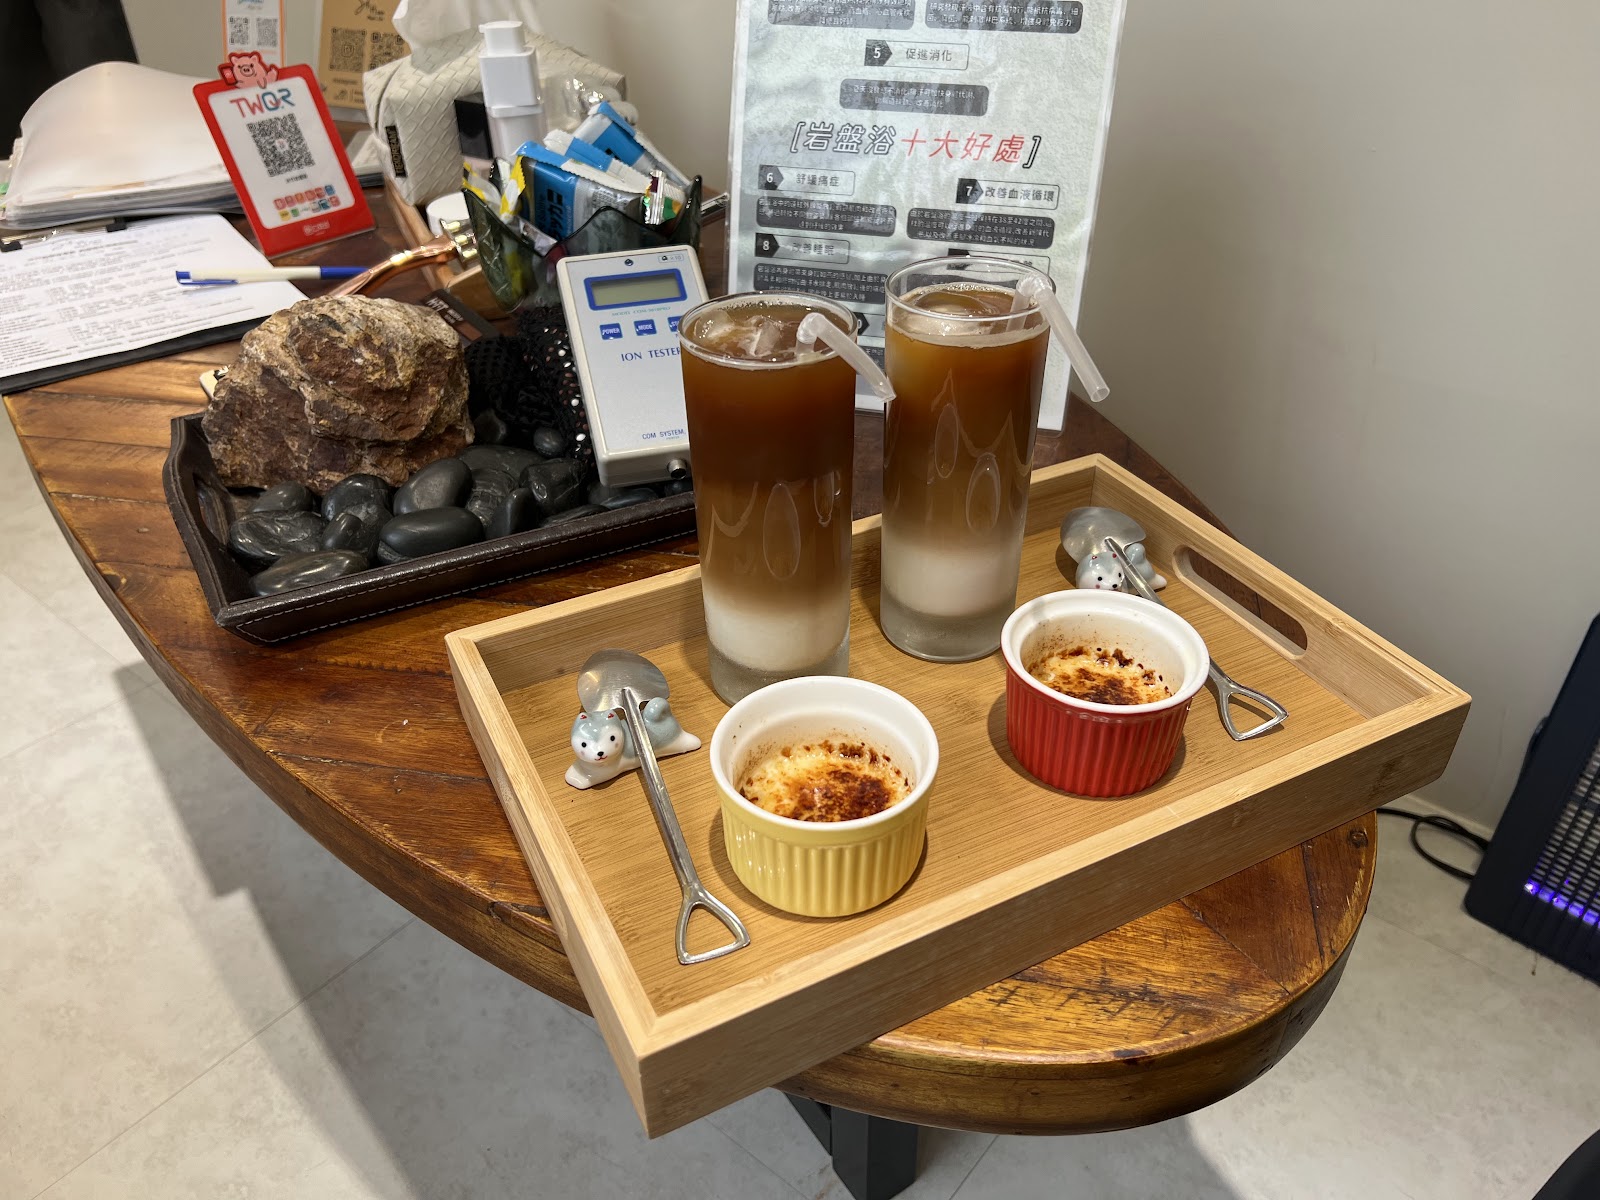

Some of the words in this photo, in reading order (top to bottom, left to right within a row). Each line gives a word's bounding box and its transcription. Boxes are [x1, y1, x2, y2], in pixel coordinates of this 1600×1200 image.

[873, 47, 881, 59] 5
[905, 48, 952, 62] 促進消化
[229, 88, 295, 118] TWQR
[766, 172, 774, 183] 6
[965, 185, 973, 197] 7
[984, 186, 1055, 202] 改善血液循環
[762, 240, 770, 251] 8
[602, 327, 620, 335] POWER
[638, 323, 653, 331] MODE
[621, 351, 643, 362] ION
[642, 432, 657, 440] COM
